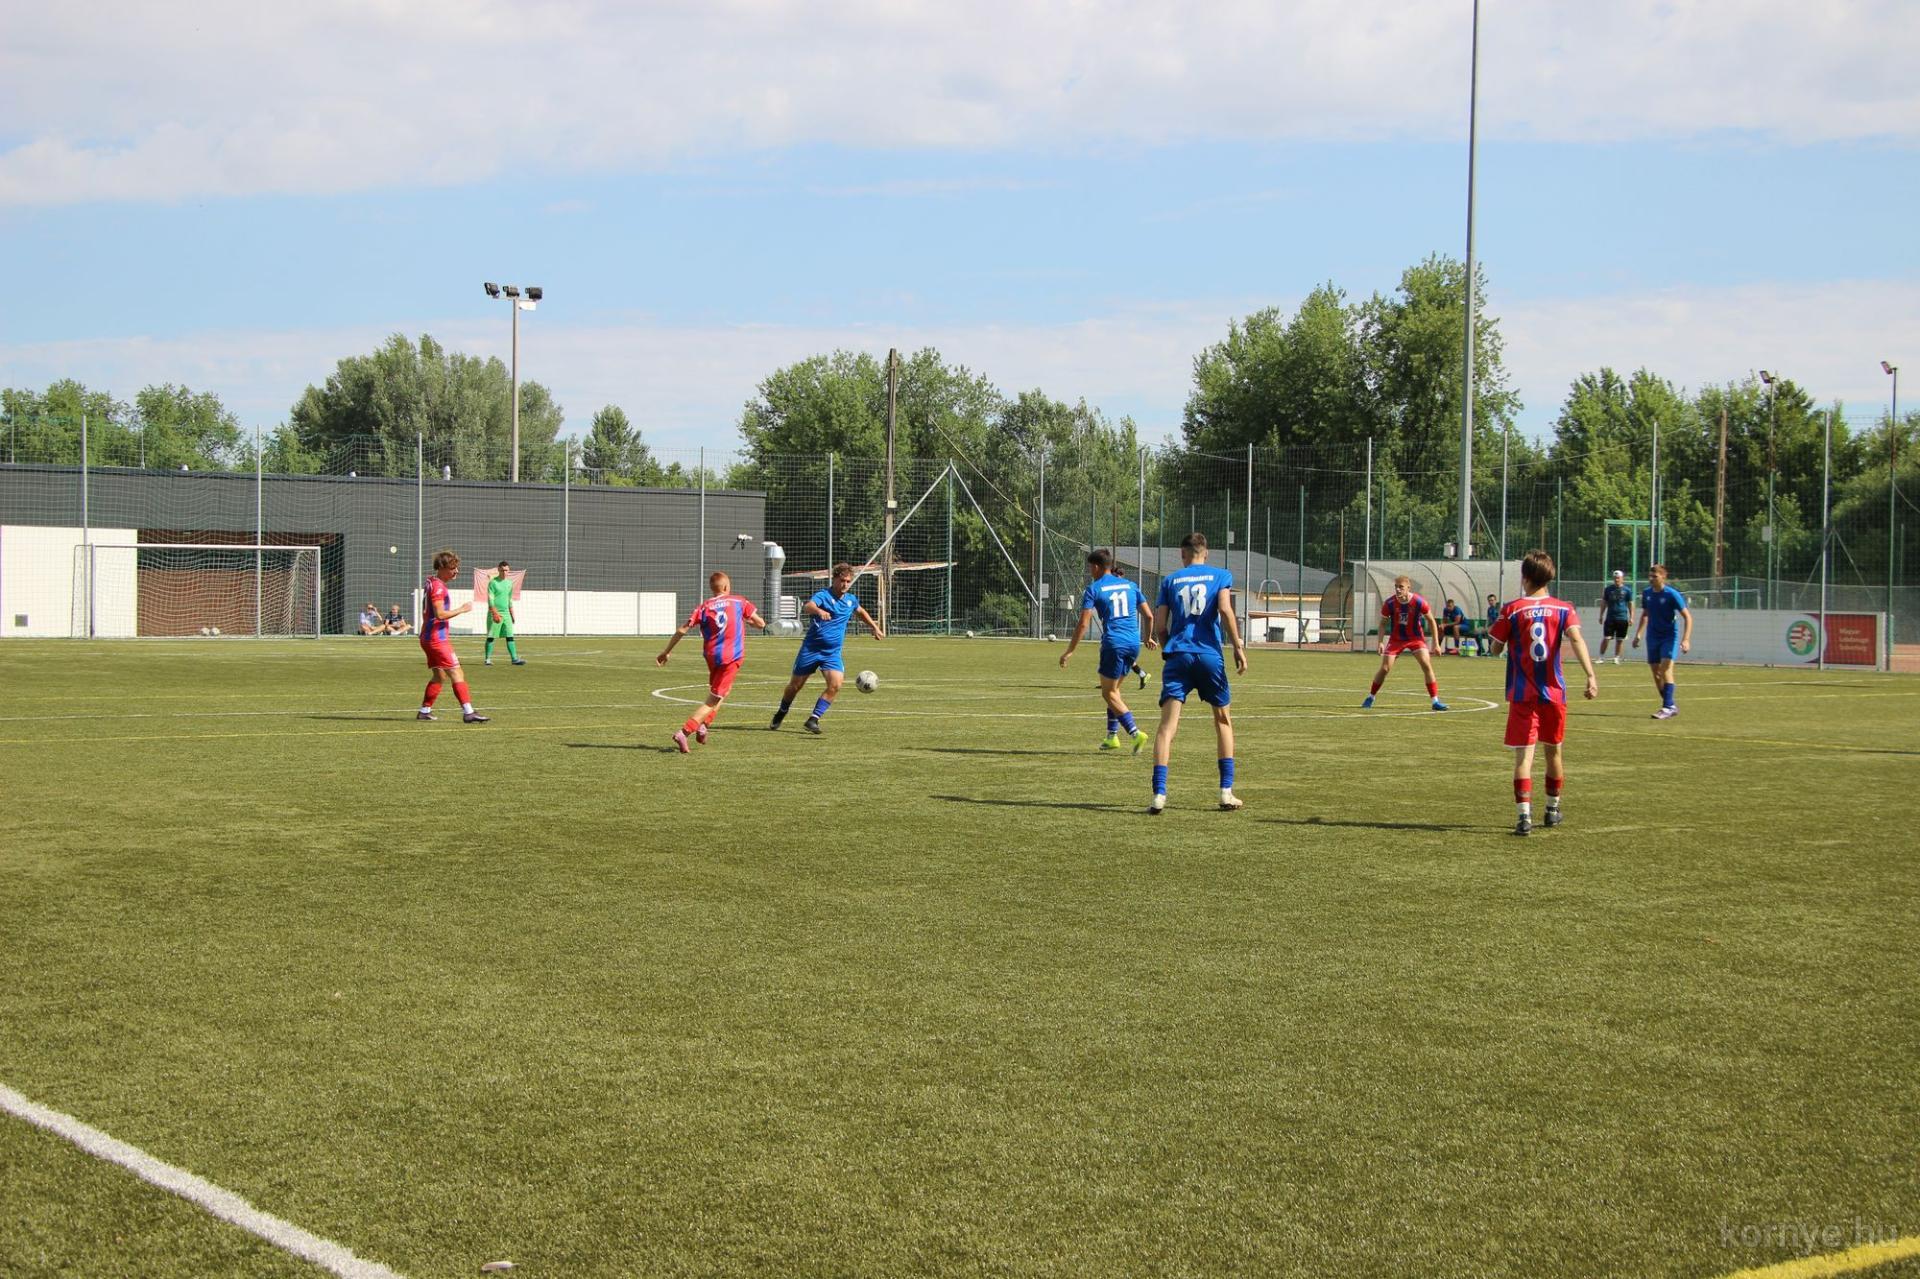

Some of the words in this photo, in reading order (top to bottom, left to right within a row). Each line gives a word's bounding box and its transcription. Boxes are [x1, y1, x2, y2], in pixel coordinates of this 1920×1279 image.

[1109, 590, 1129, 617] 11
[714, 611, 729, 636] 9
[1530, 622, 1549, 662] 8
